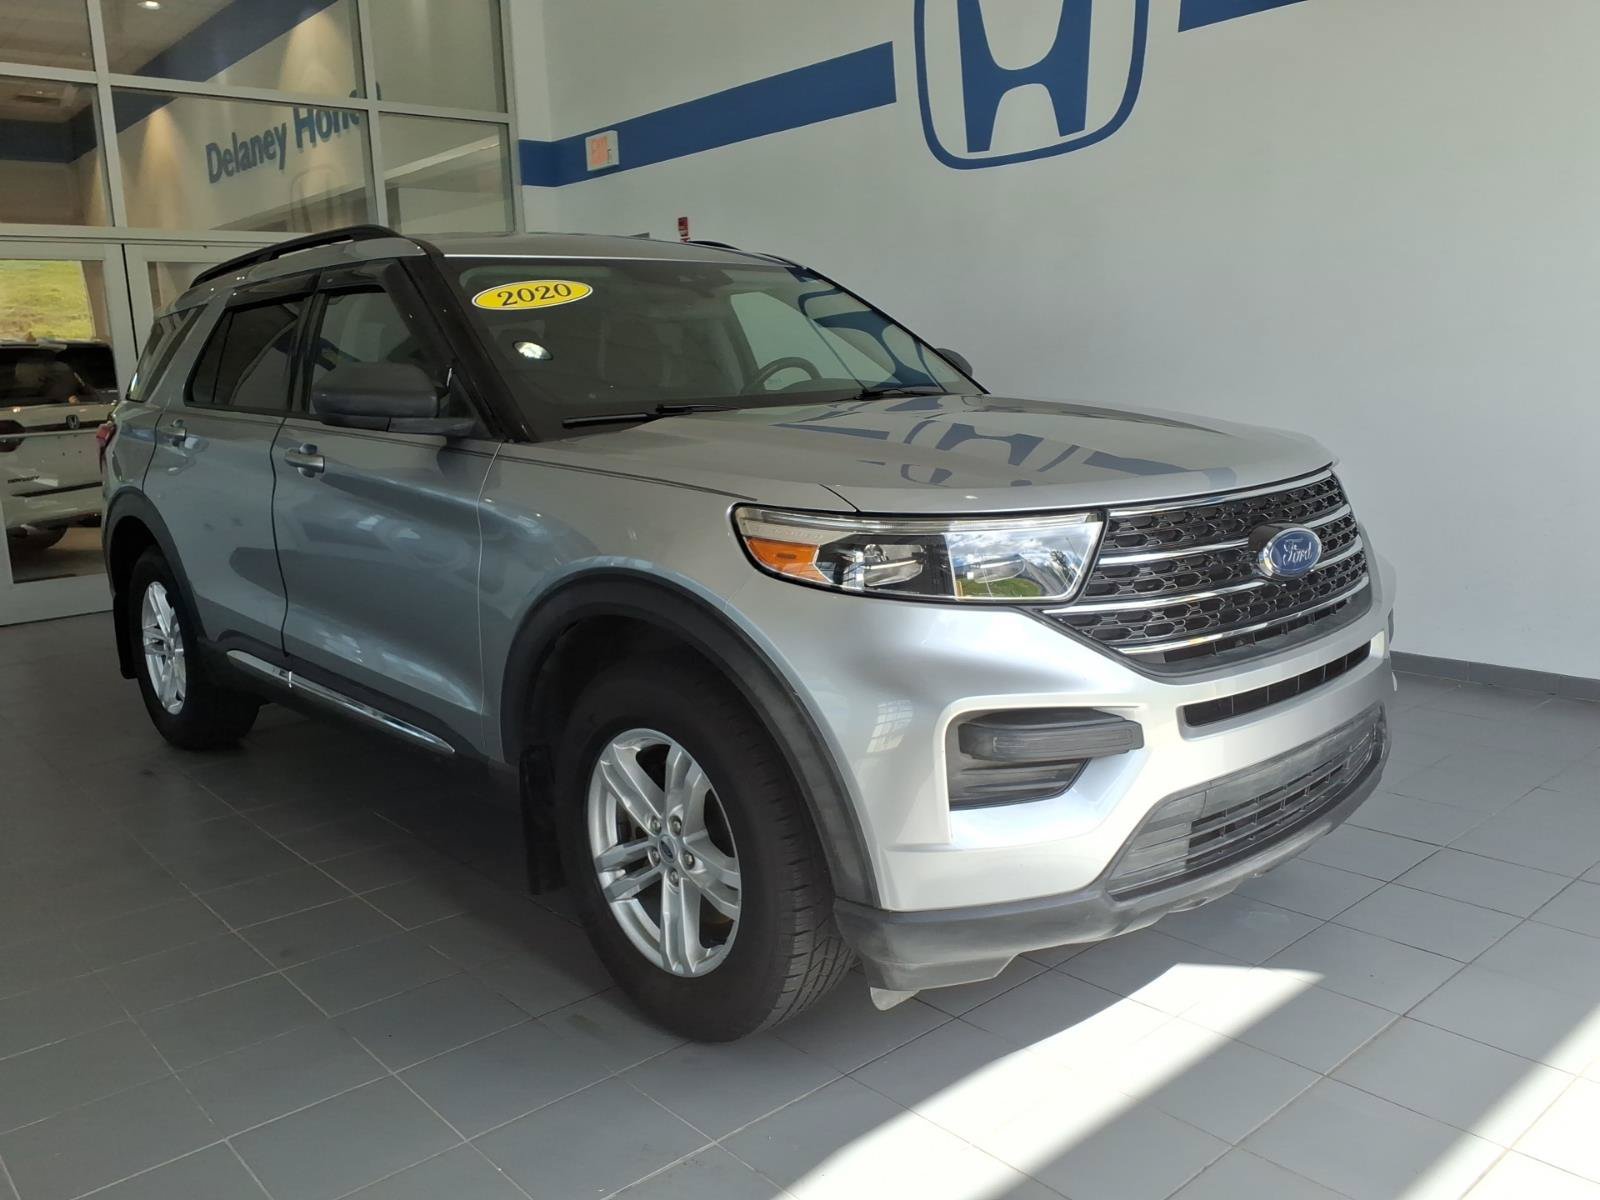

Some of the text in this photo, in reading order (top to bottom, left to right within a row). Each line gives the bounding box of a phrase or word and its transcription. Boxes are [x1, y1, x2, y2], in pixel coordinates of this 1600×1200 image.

[205, 82, 382, 183] Delaney Hon
[497, 283, 572, 307] 2020
[1282, 538, 1313, 567] Ford
